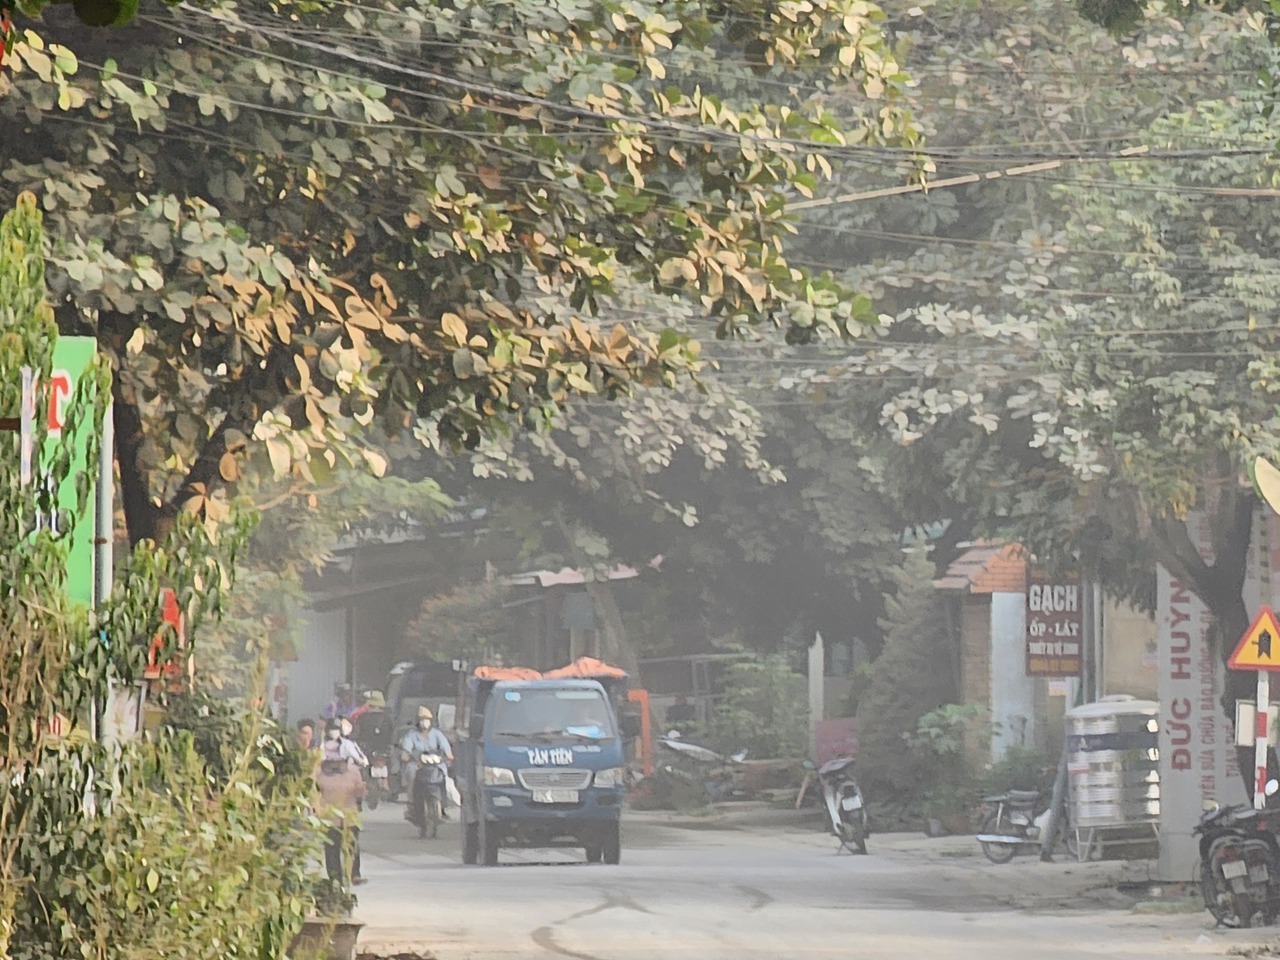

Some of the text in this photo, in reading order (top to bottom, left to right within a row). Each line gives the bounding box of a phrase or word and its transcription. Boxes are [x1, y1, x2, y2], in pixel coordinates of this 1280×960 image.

[1028, 584, 1078, 616] GẠCH
[1055, 618, 1079, 637] LÁT
[1166, 697, 1192, 772] ĐỨC
